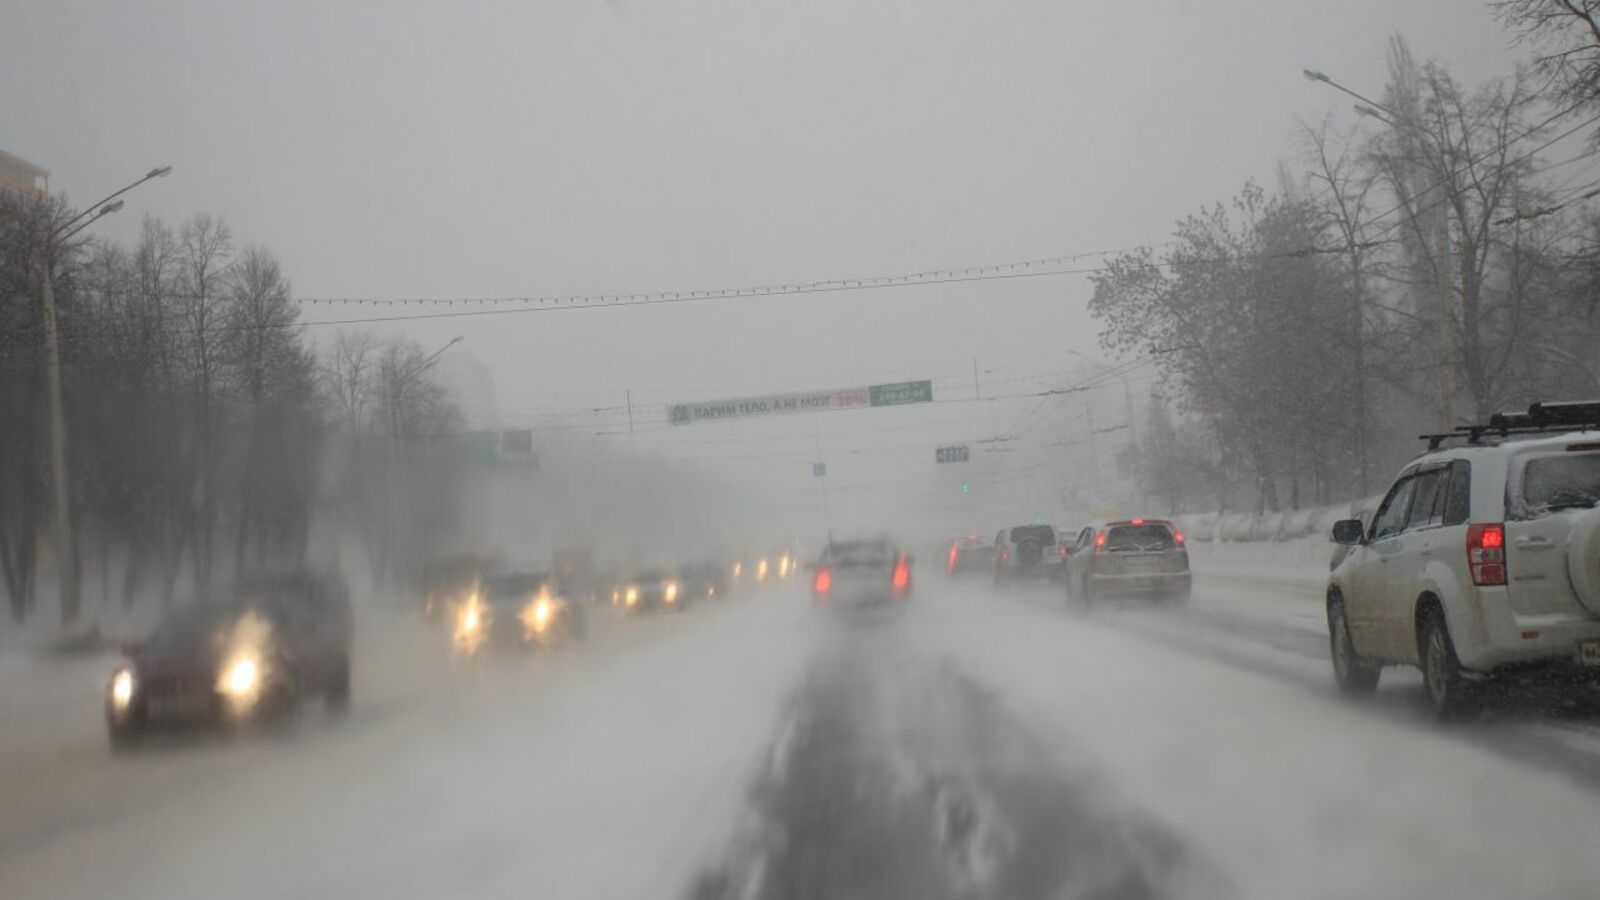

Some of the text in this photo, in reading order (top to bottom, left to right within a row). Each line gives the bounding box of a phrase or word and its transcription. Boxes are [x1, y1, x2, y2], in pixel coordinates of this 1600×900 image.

[694, 405, 736, 418] ПАРИМ
[772, 399, 782, 411] А
[783, 398, 798, 410] НЕ
